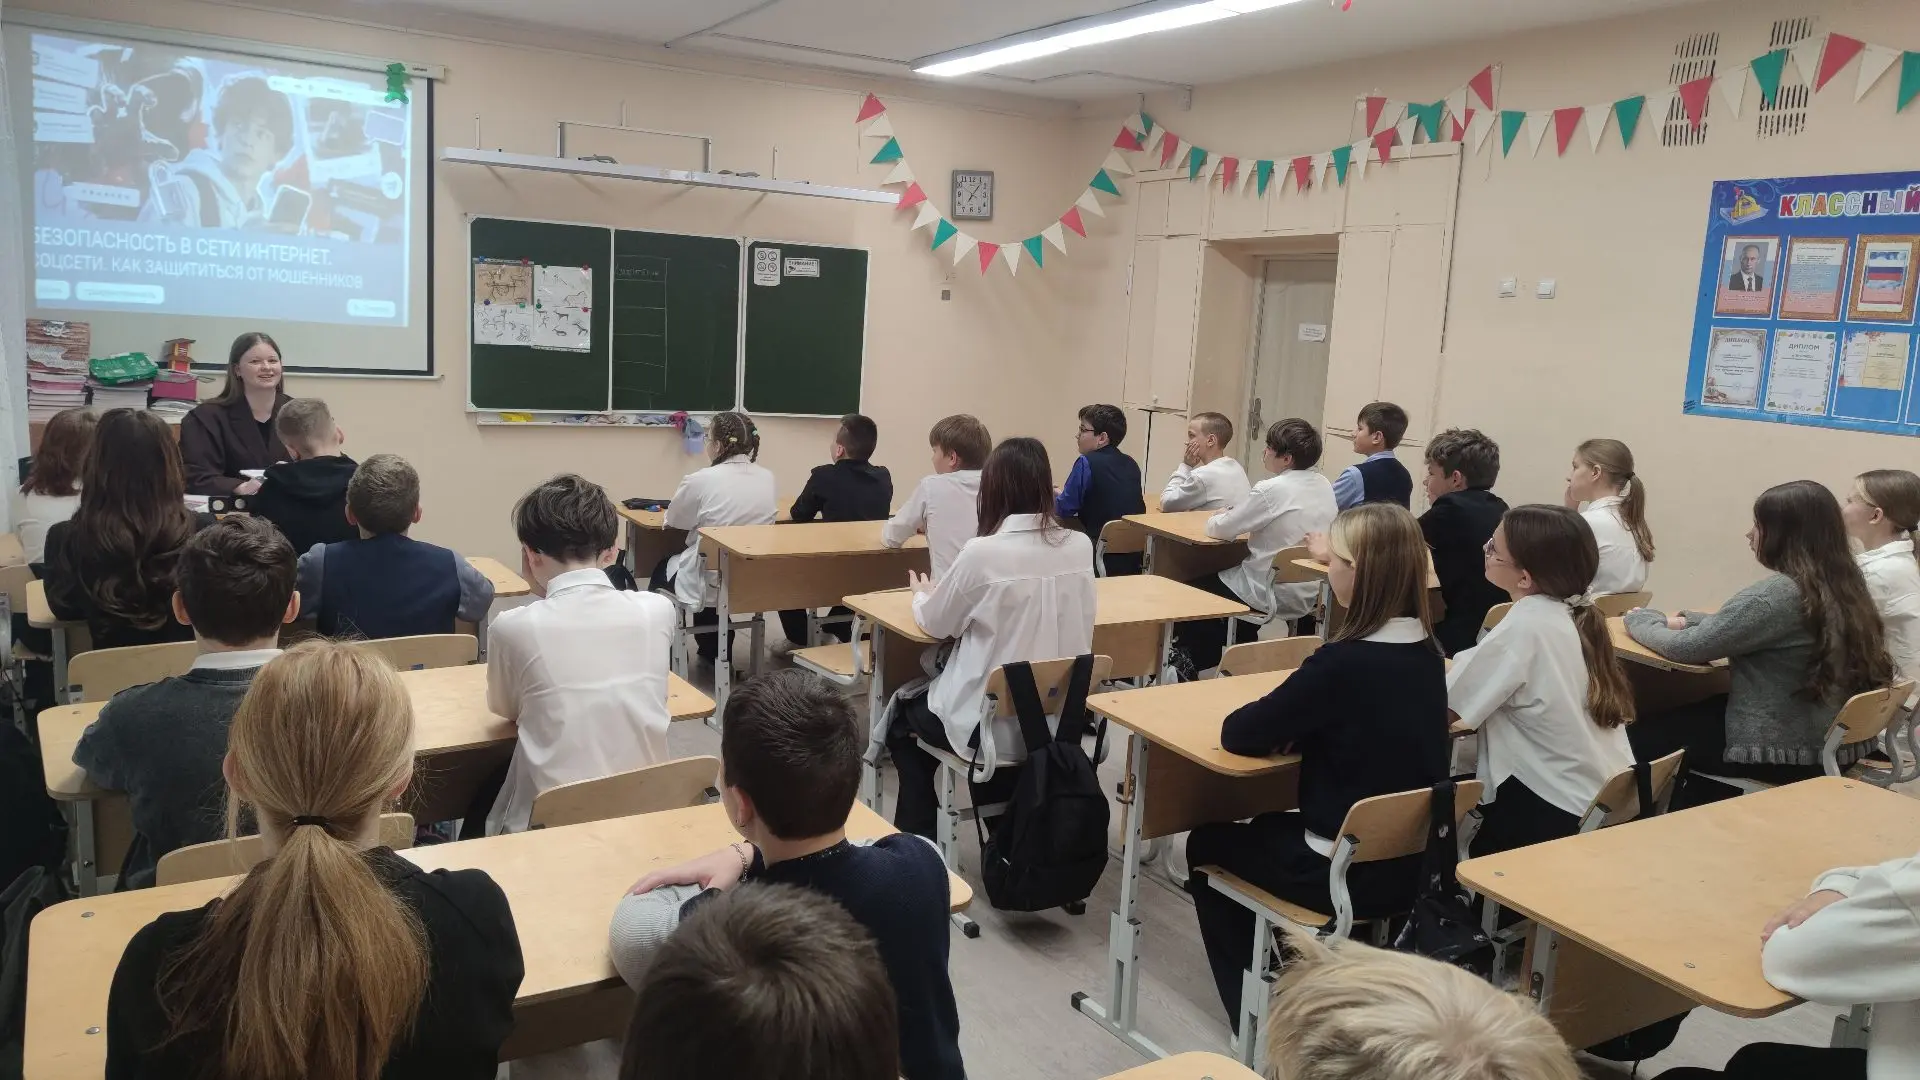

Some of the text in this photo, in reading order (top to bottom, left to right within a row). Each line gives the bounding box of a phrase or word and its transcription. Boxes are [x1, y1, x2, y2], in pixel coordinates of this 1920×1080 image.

[1779, 184, 1920, 217] КЛАССНЫЙ
[181, 237, 192, 255] В
[196, 238, 241, 258] СЕТИ
[245, 242, 333, 266] ИНТЕРНЕТ.
[112, 257, 142, 273] КАК
[146, 260, 243, 280] ЗАЩИТИТЬСЯ
[247, 266, 264, 281] ОТ
[268, 268, 363, 289] МОШЕННИКОВ
[1788, 343, 1820, 351] ДИПЛОМ
